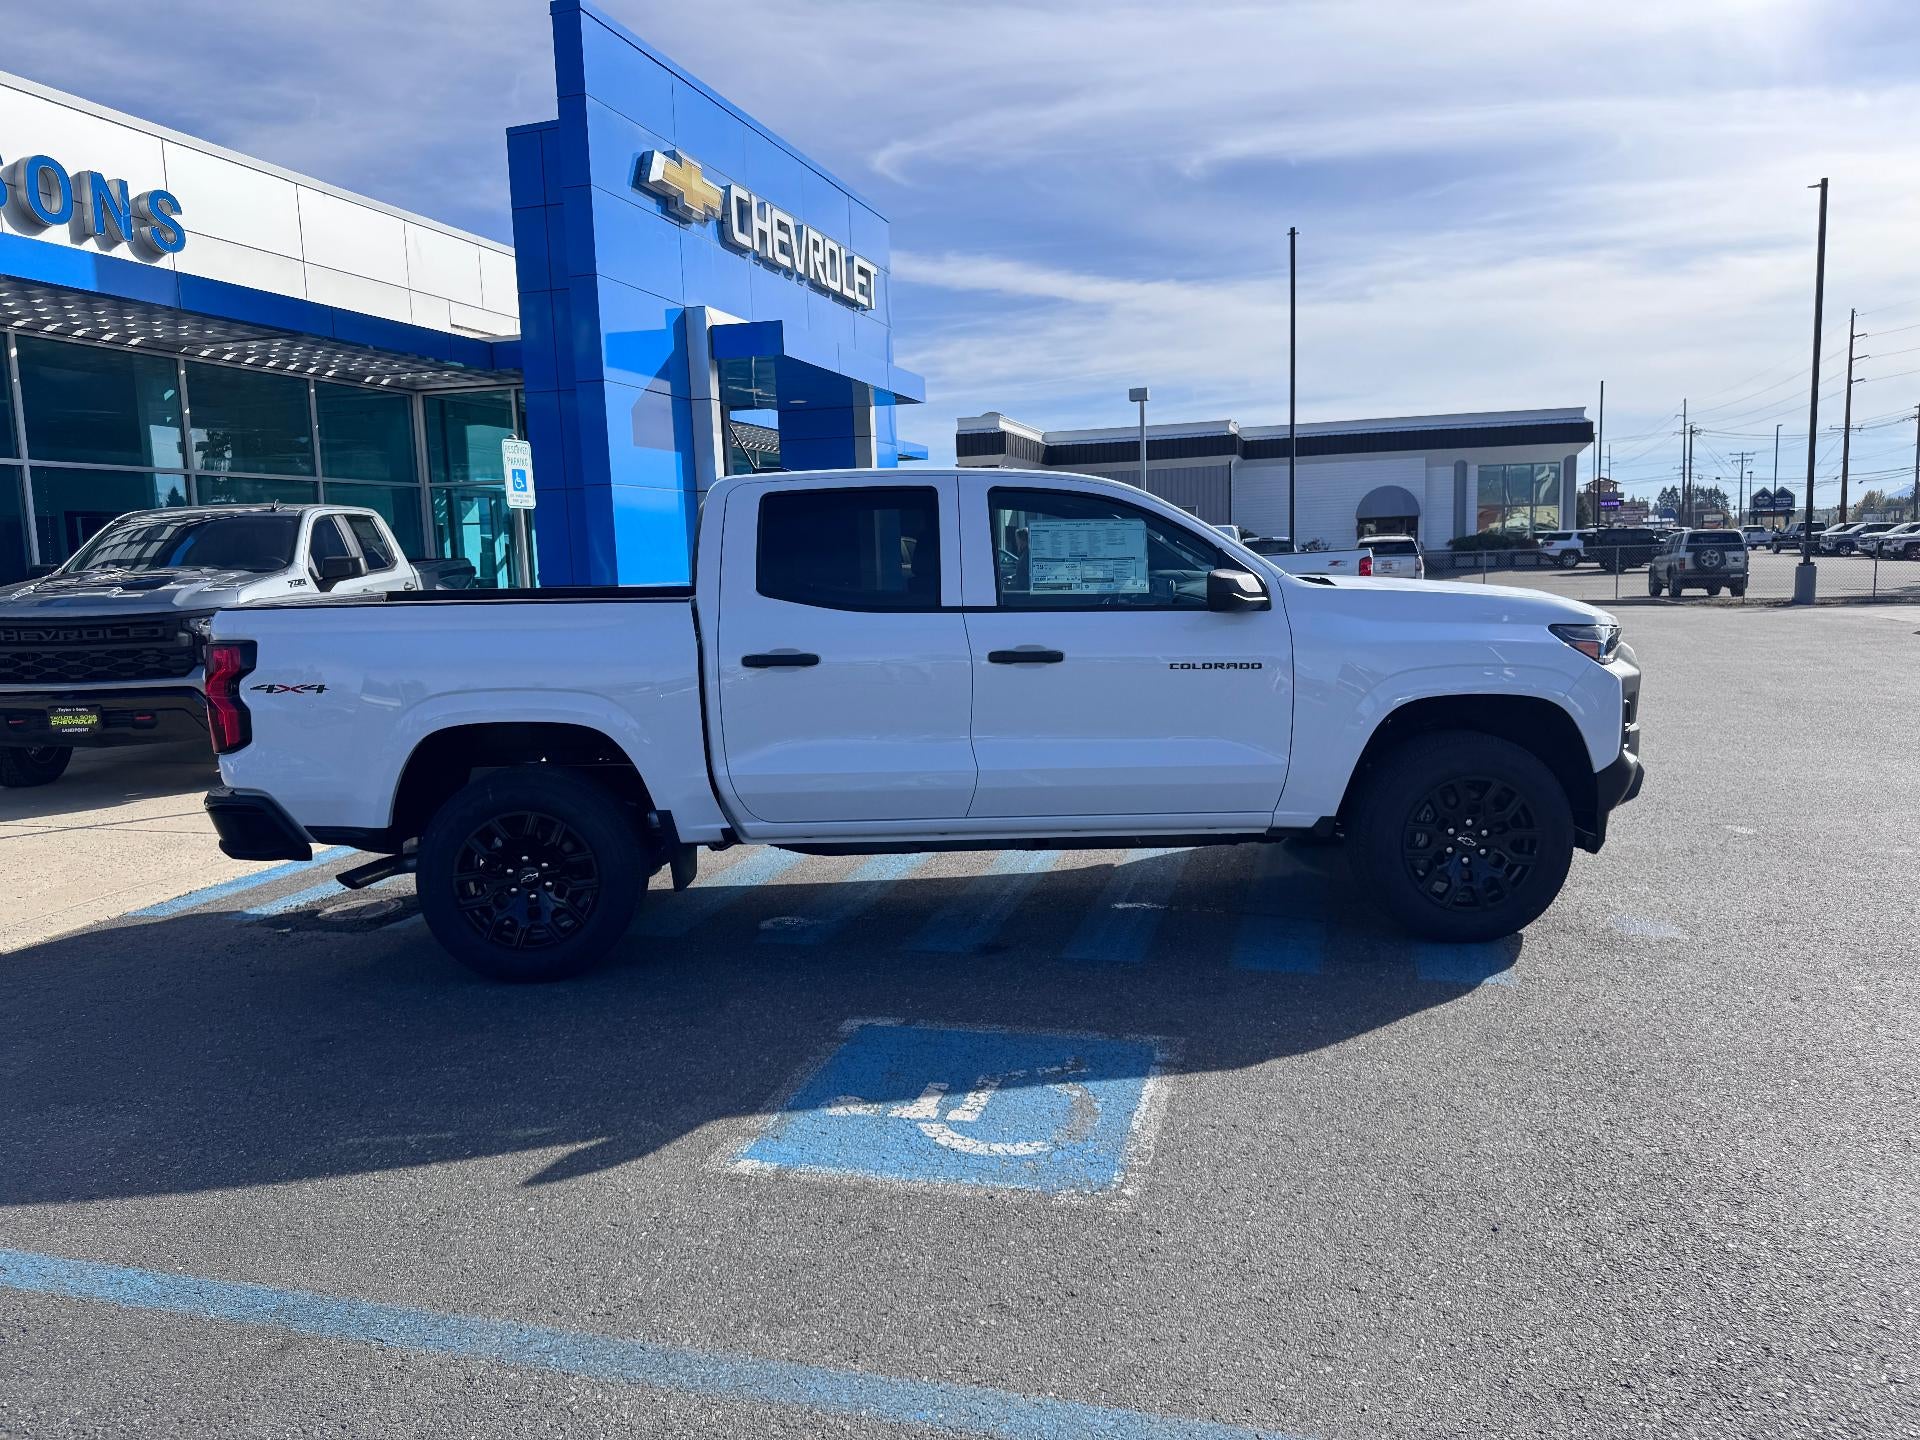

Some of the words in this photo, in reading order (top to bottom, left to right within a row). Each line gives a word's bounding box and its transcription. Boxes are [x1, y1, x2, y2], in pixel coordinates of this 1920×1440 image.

[729, 183, 879, 310] CHEVROLET
[507, 456, 528, 467] PARKING
[0, 625, 166, 642] HEVROLET
[1169, 662, 1262, 670] COLORADO
